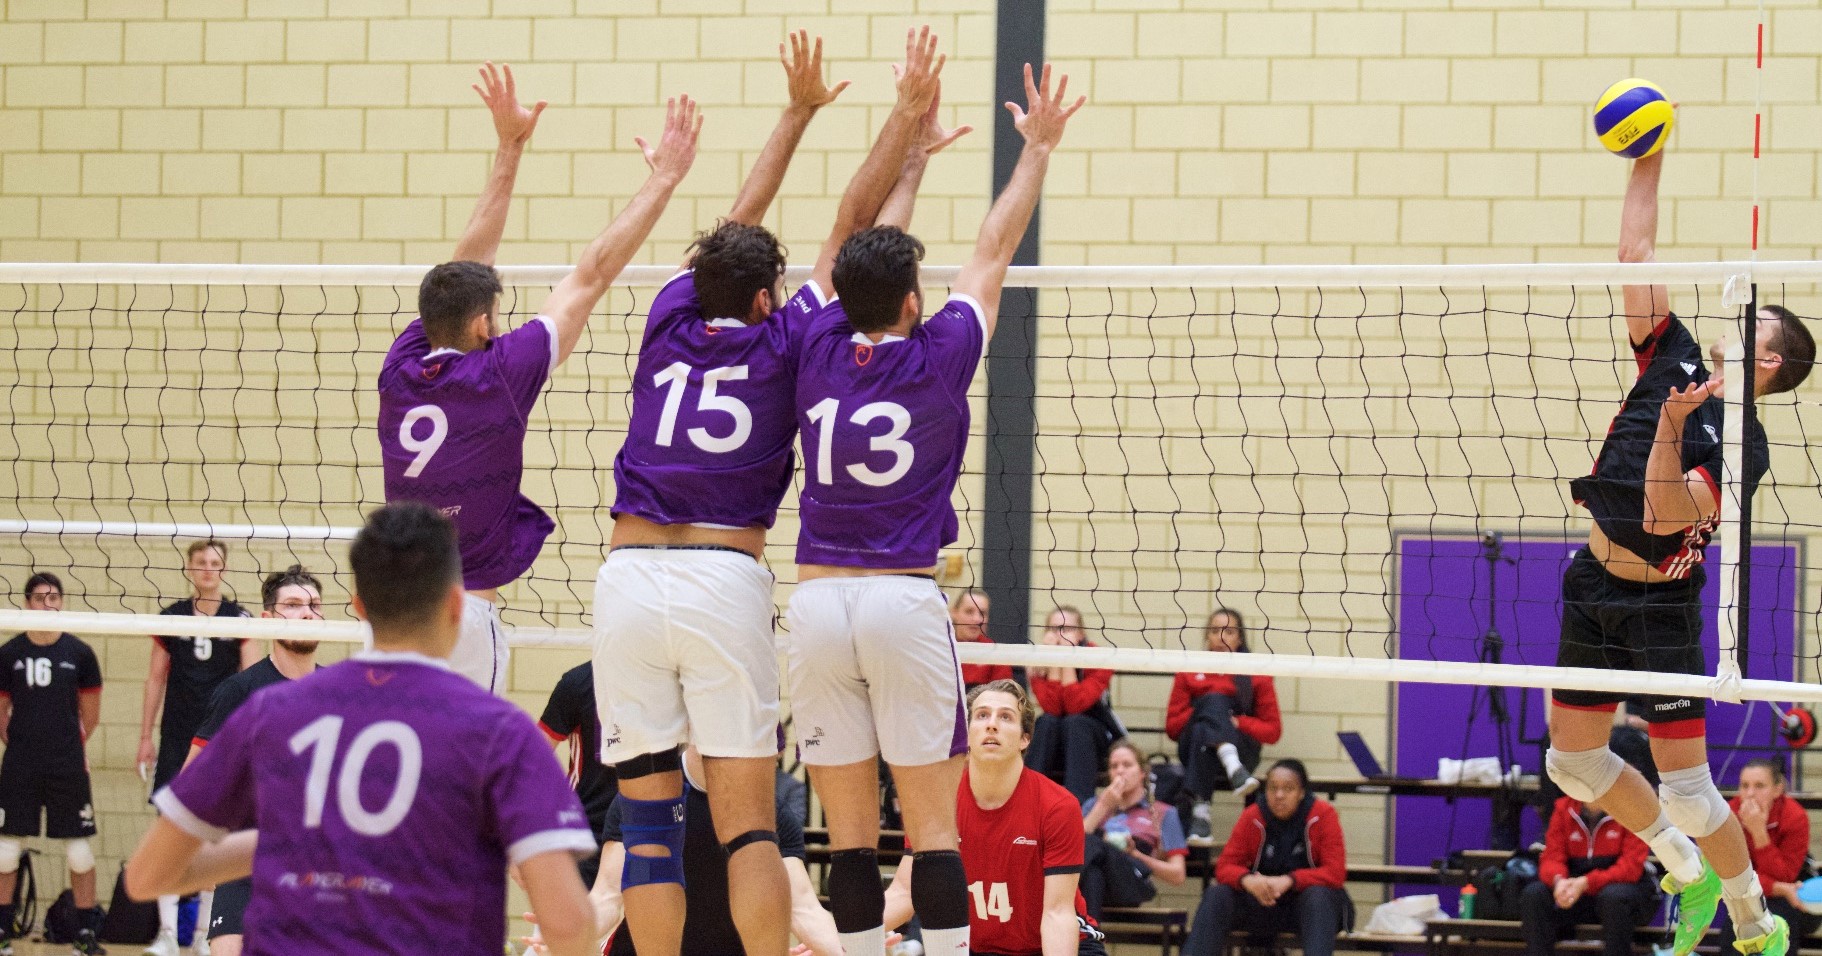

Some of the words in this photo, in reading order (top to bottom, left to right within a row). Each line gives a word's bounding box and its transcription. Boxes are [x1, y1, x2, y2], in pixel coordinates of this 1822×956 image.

[653, 361, 753, 453] 15
[399, 404, 449, 478] 9
[806, 397, 915, 487] 13
[194, 635, 212, 661] 5
[25, 656, 52, 687] 16
[1654, 699, 1691, 711] macron
[606, 736, 621, 748] pwc
[804, 739, 821, 748] pwc
[290, 715, 423, 836] 10
[967, 880, 1014, 923] 14
